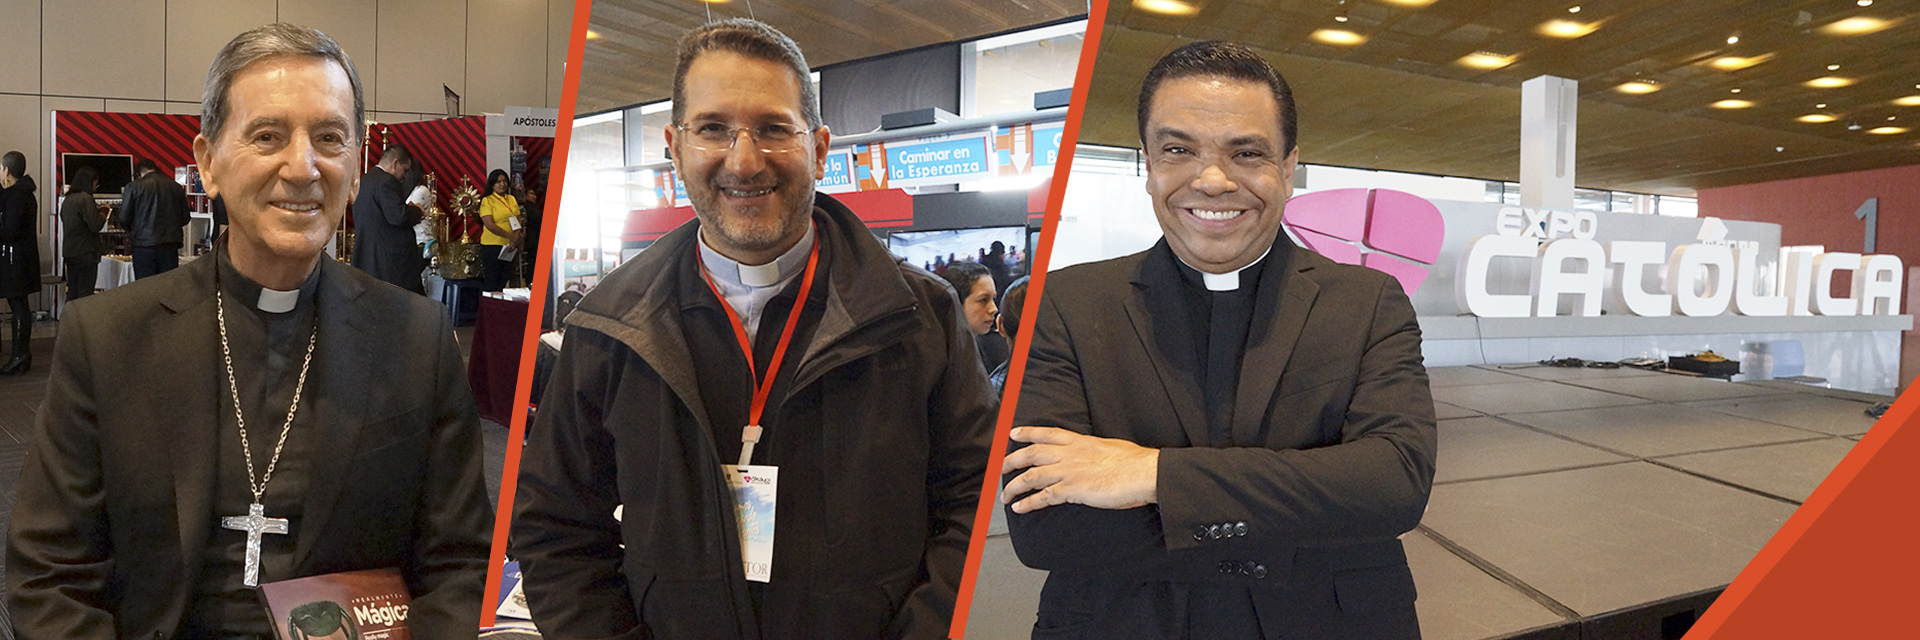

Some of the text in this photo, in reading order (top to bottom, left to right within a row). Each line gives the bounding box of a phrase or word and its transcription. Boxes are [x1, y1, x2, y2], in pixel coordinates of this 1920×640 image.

[513, 115, 557, 128] APÓSTOLES
[831, 157, 842, 171] la
[899, 147, 970, 165] Caminar en
[815, 171, 849, 187] omún
[891, 161, 980, 179] la Esperanza
[1496, 206, 1598, 241] EXPO
[1854, 197, 1878, 254] 1
[1460, 216, 1904, 318] CATÓLICA
